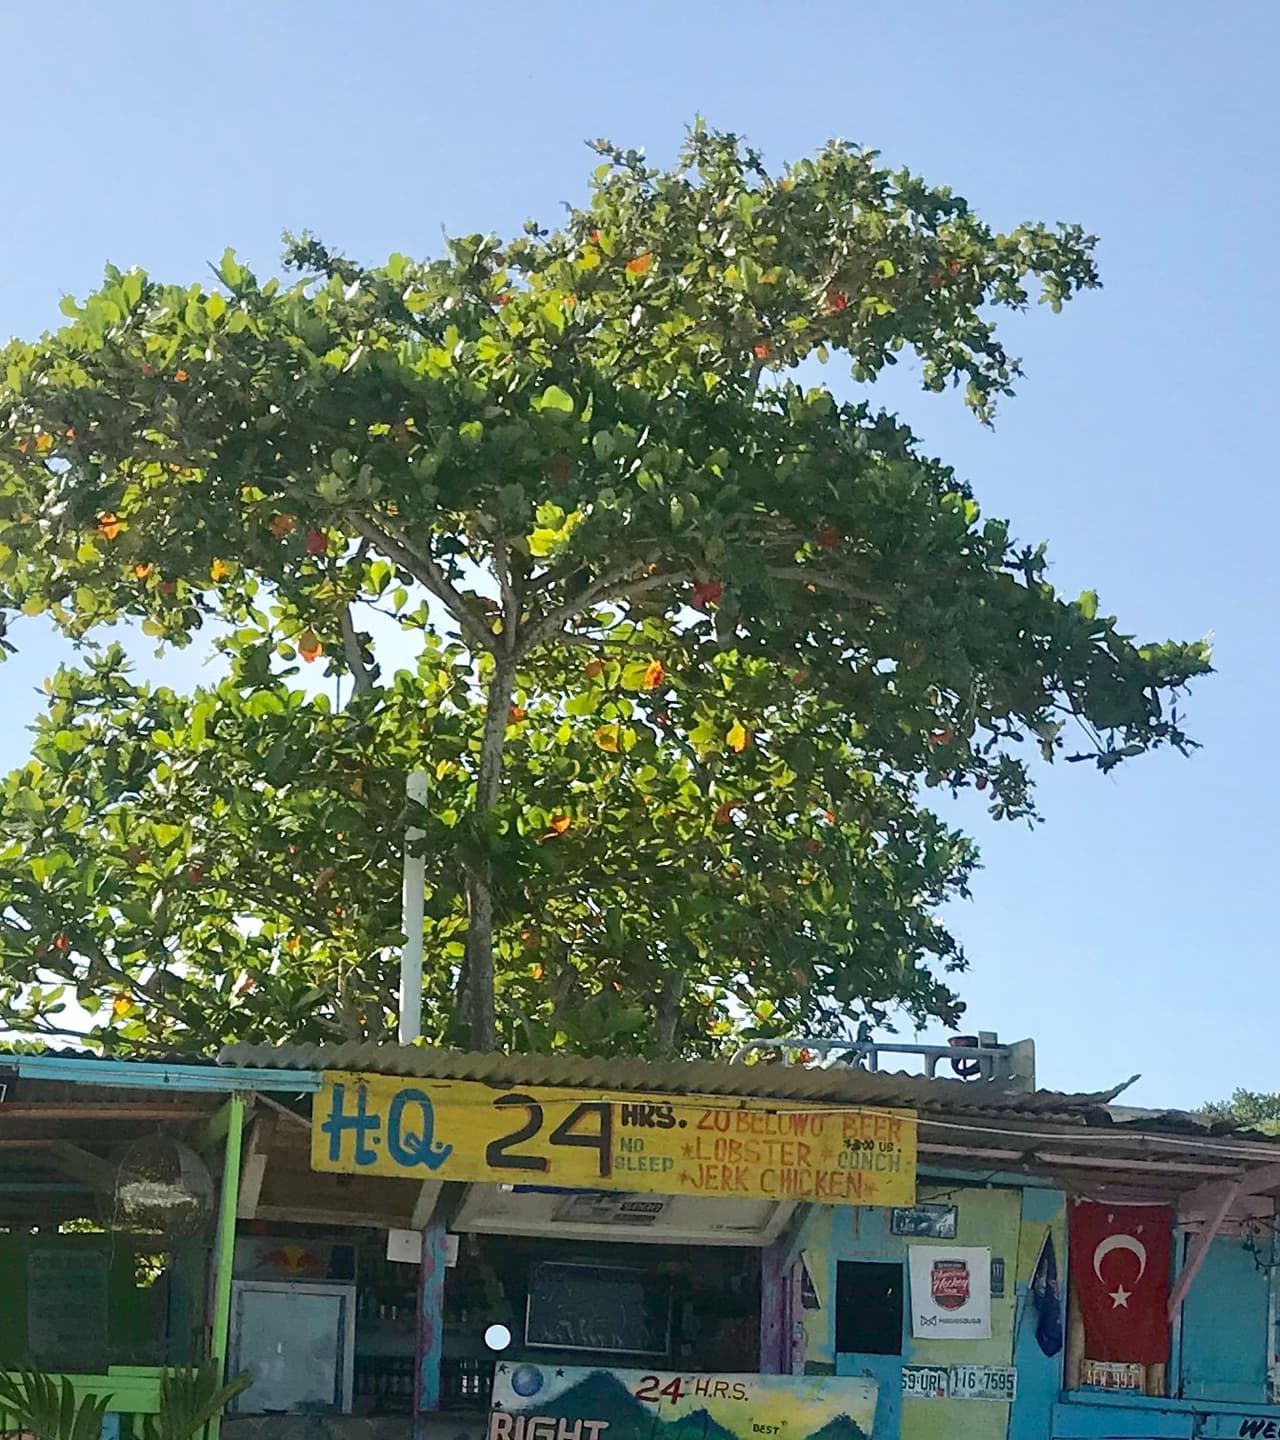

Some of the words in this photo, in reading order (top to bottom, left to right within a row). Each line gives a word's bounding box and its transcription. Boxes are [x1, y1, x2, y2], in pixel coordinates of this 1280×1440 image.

[621, 1101, 688, 1130] HRS.
[841, 1112, 903, 1143] BEER
[485, 1093, 613, 1179] 24
[619, 1136, 645, 1154] NO
[613, 1154, 675, 1173] SLEEP
[837, 1151, 903, 1174] CONCH
[691, 1162, 750, 1194] JERK
[760, 1167, 863, 1199] CHICKEN
[635, 1376, 685, 1406] 24
[983, 1372, 1015, 1391] 7595
